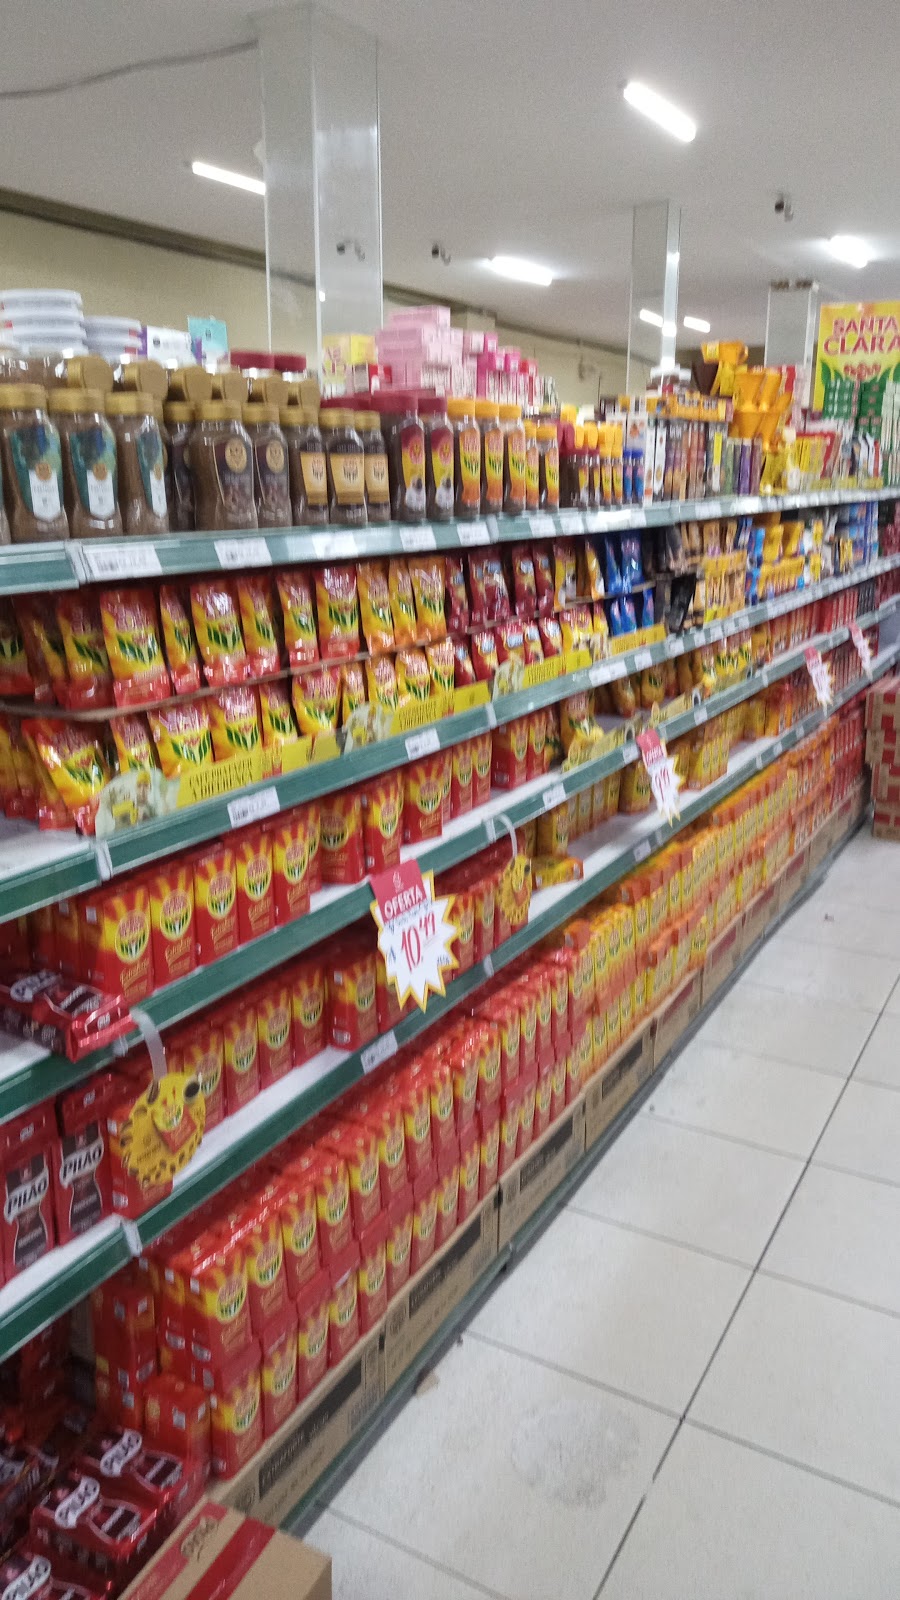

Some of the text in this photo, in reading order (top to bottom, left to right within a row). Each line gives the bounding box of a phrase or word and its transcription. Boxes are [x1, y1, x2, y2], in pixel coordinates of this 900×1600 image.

[833, 316, 899, 339] SANTA
[823, 333, 900, 355] CLARA
[384, 884, 423, 920] OFERTA
